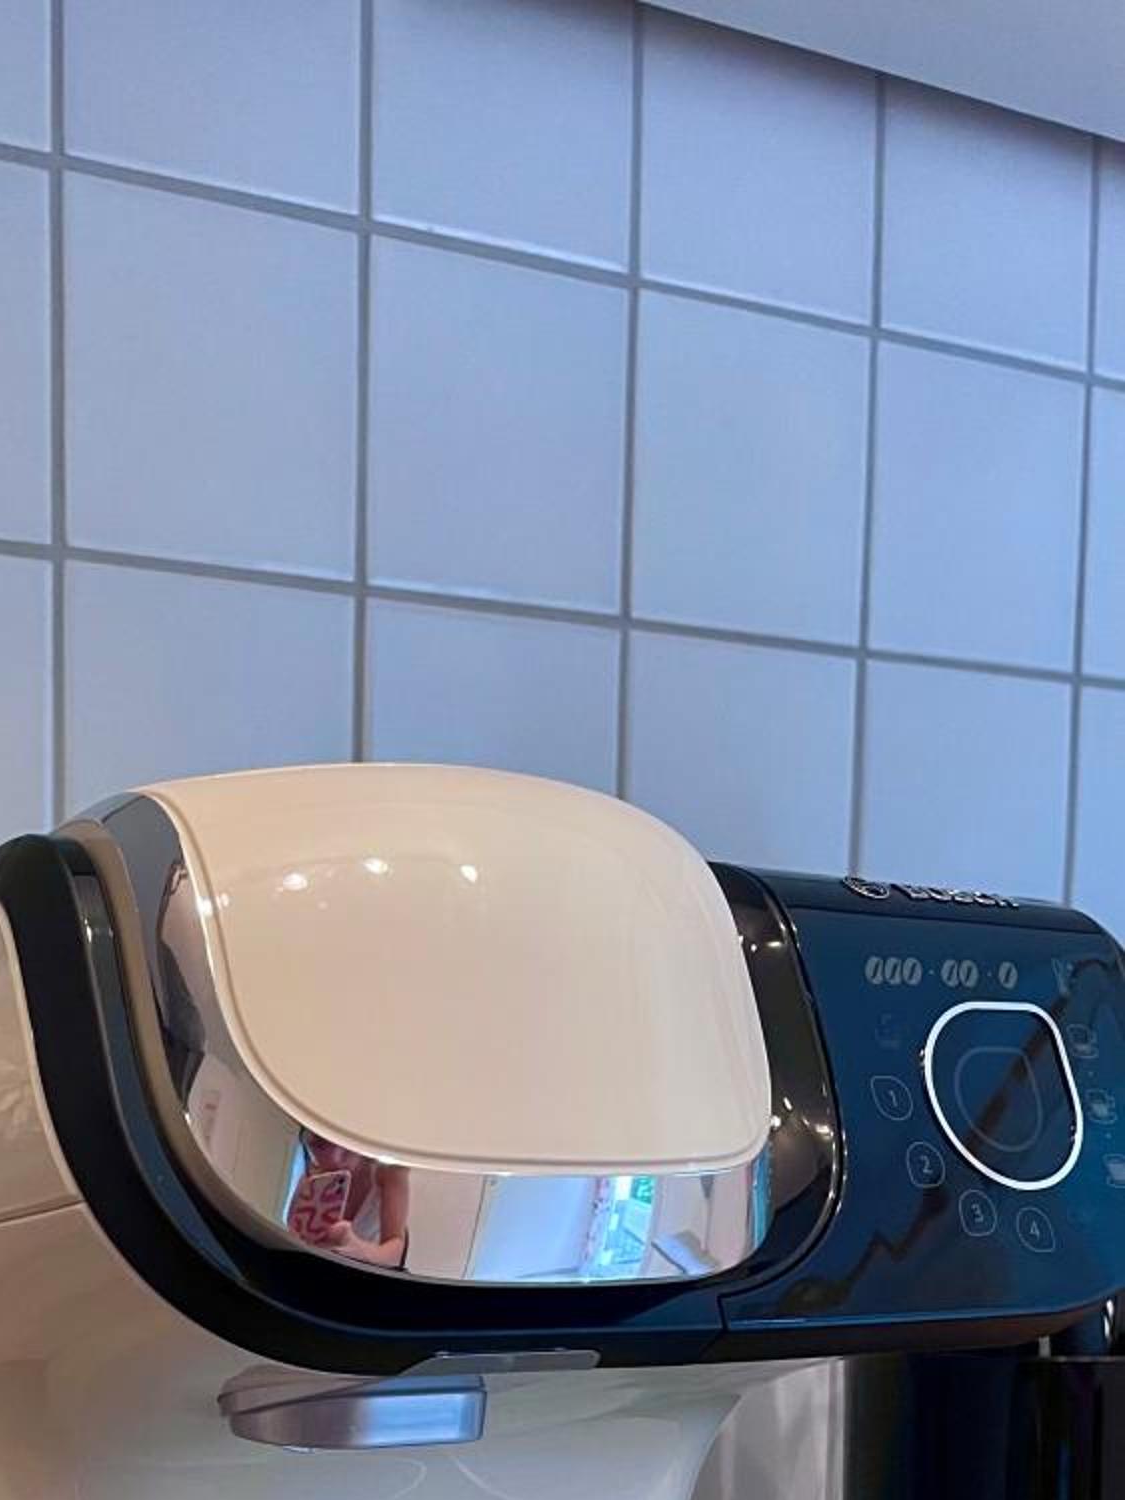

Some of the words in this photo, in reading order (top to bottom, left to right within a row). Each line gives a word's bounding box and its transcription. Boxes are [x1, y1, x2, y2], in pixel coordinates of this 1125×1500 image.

[919, 1155, 933, 1174] 2
[971, 1204, 984, 1223] 3
[1029, 1220, 1041, 1240] 4
